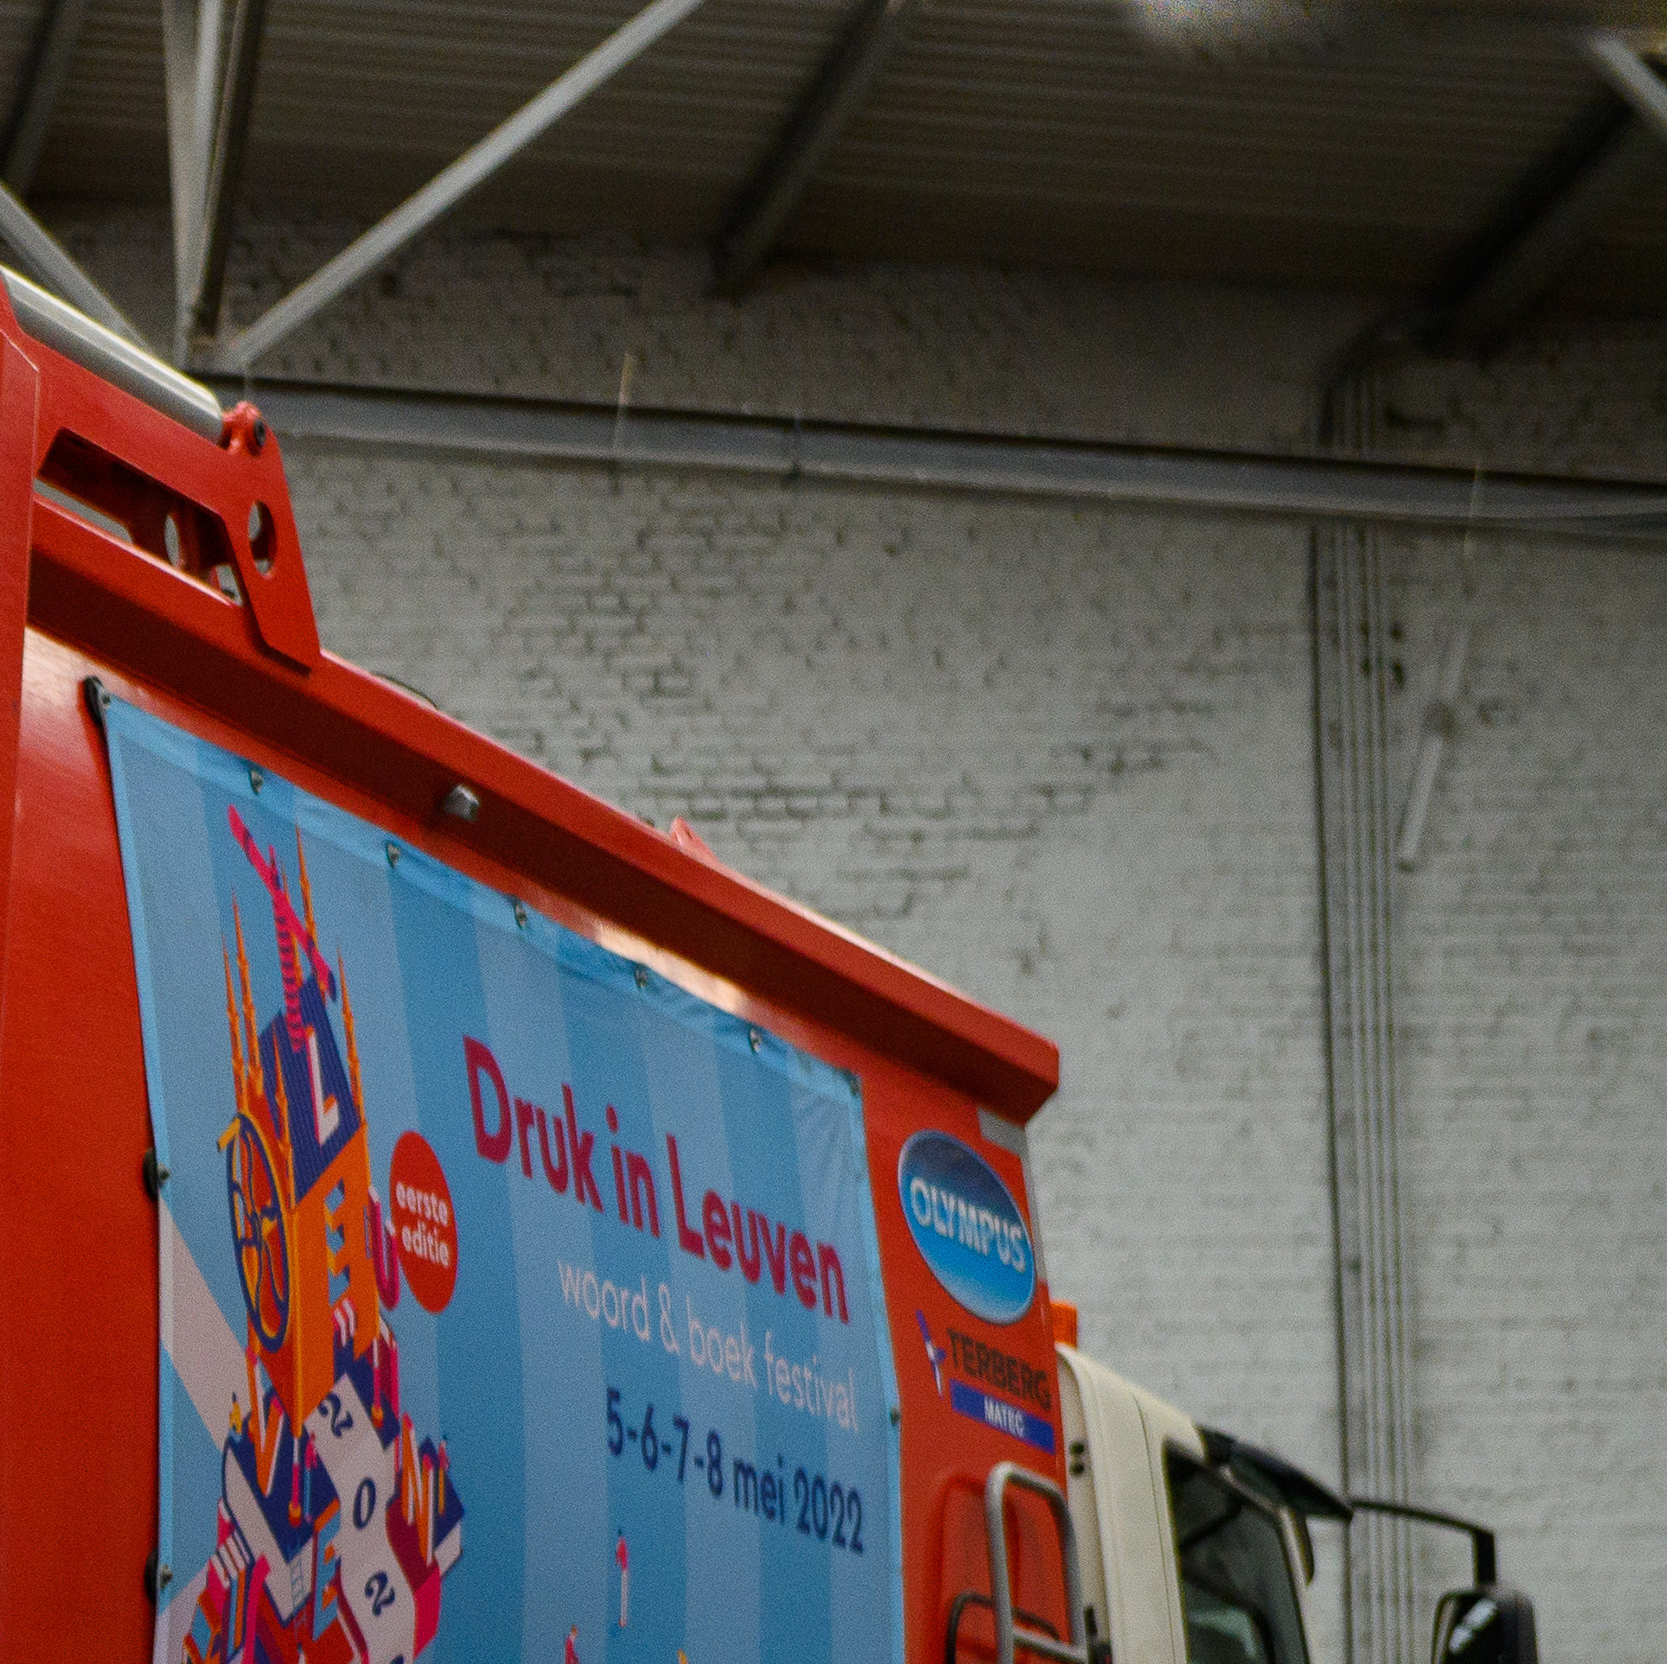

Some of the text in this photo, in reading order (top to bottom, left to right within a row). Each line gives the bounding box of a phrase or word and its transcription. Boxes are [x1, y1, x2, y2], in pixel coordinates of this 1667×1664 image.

[395, 1181, 449, 1228] eerste
[463, 1033, 850, 1325] Druk in Leuven
[910, 1176, 1027, 1275] OLYMPUS
[401, 1219, 450, 1270] editie
[558, 1258, 860, 1434] woord & boek festival
[946, 1326, 1053, 1412] TERBERG
[607, 1387, 864, 1556] 5-6-7-8 mei 2022
